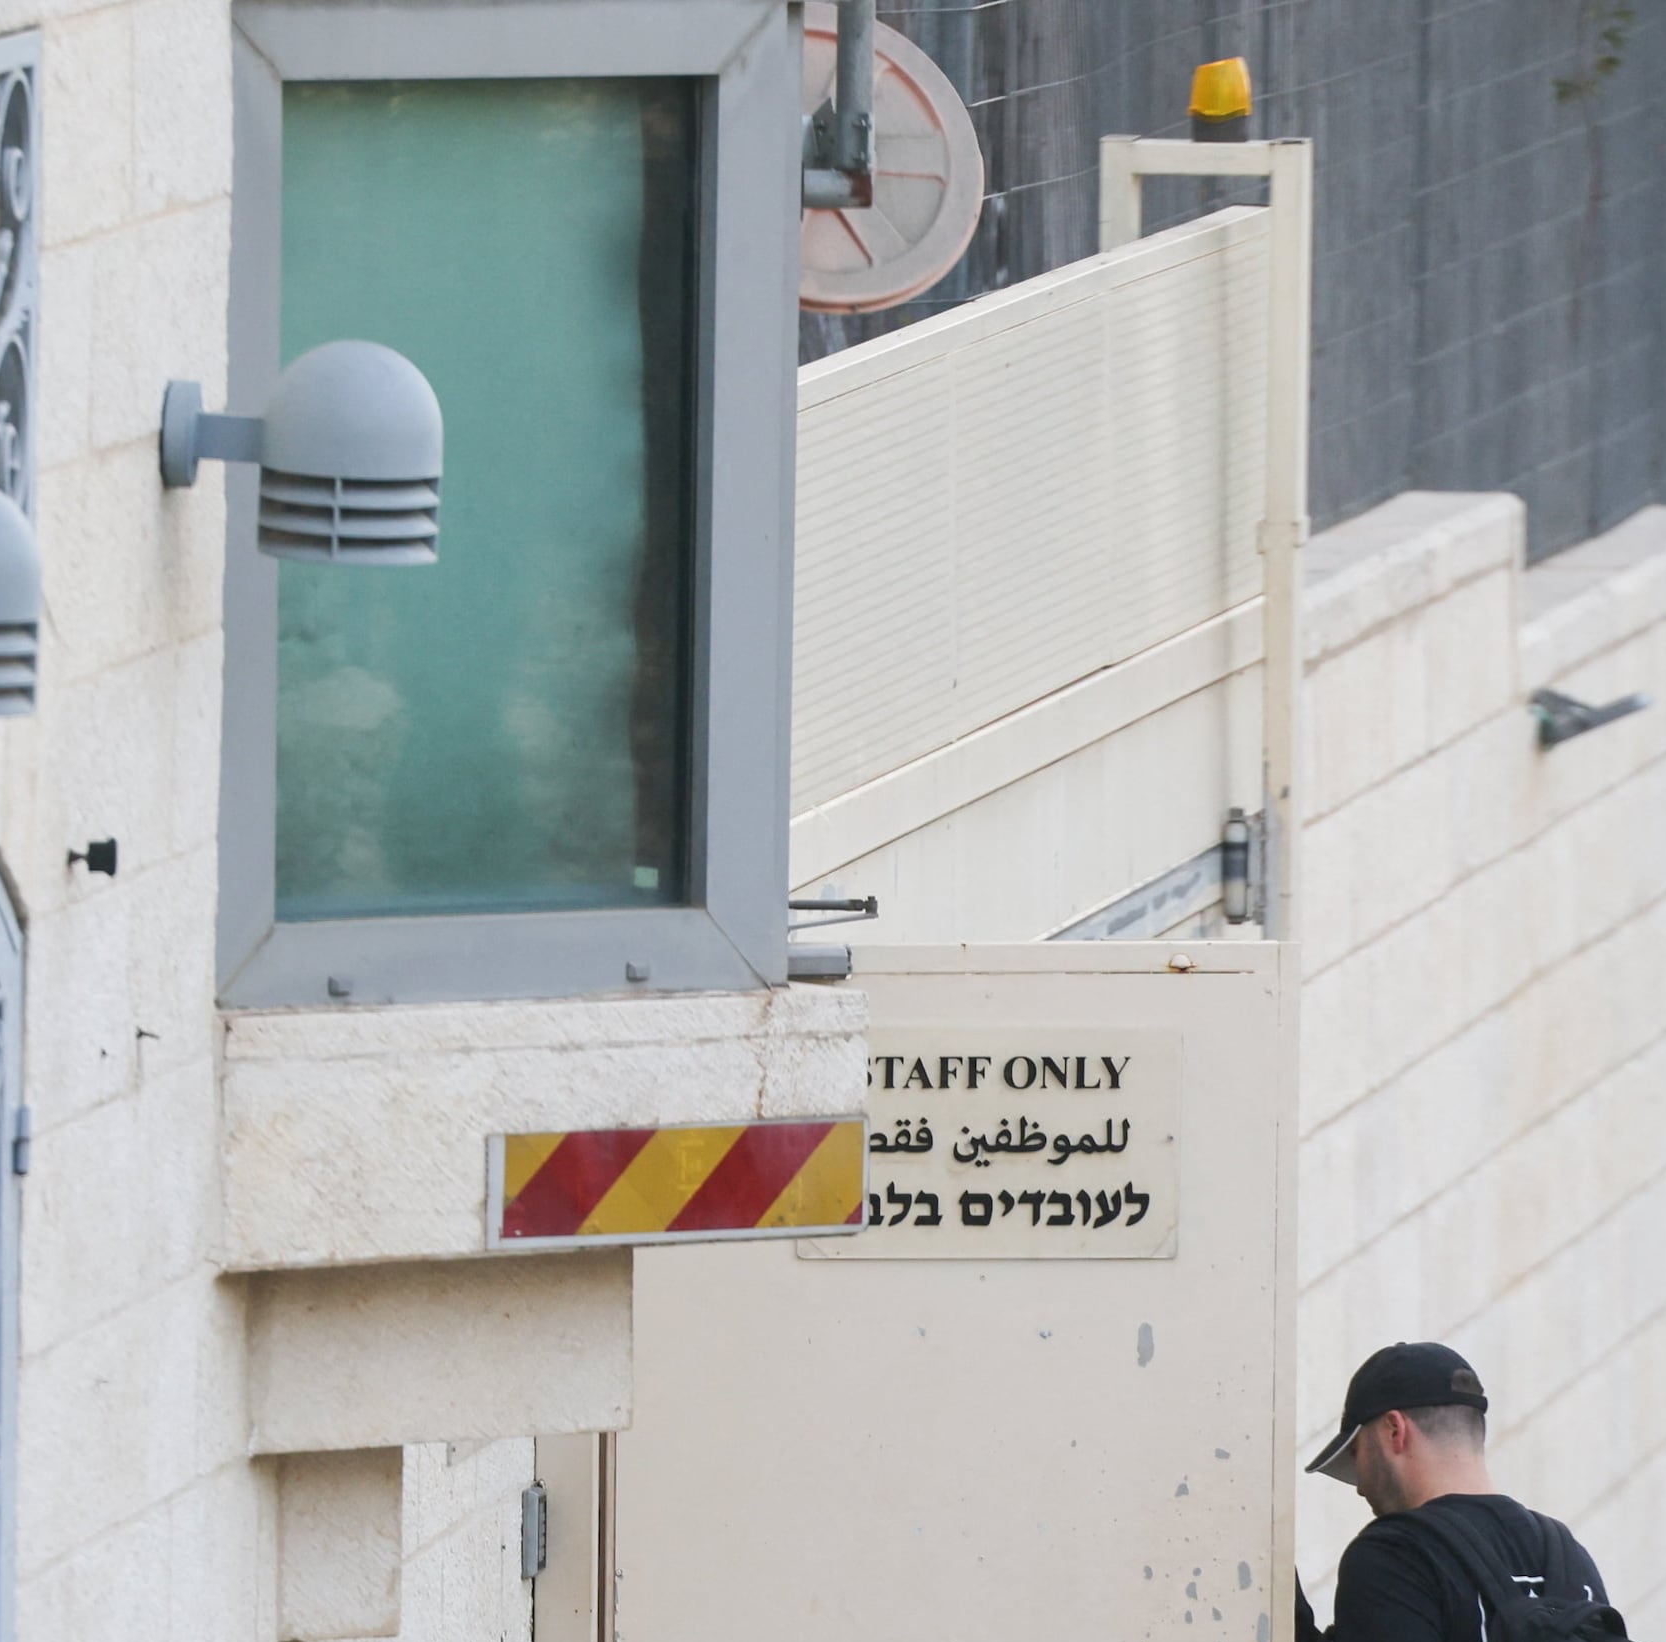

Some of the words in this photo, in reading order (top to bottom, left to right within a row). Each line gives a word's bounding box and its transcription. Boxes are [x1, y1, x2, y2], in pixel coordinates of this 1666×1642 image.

[1003, 1056, 1132, 1090] ONLY
[952, 1115, 1131, 1168] للموظفين
[958, 1181, 1151, 1230] לעובדים
